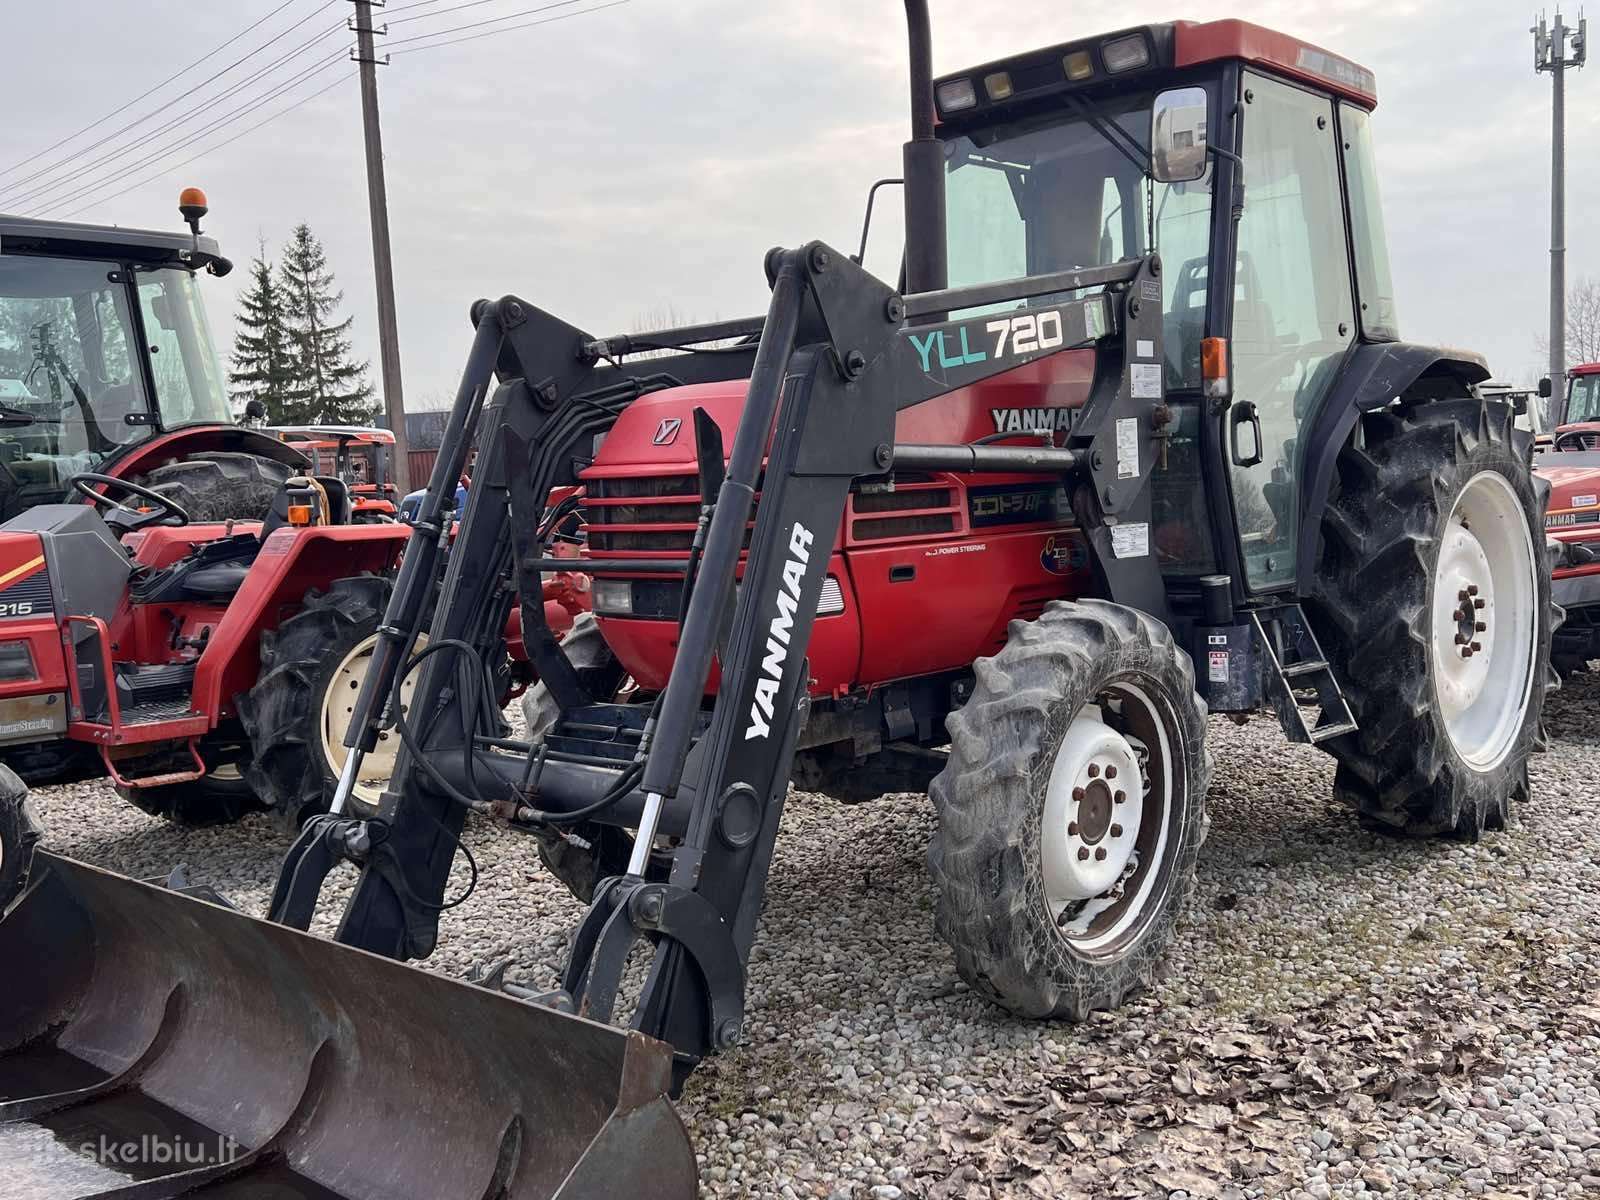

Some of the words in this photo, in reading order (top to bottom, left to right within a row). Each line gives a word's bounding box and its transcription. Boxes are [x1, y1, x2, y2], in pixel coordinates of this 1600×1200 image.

[908, 326, 987, 373] YLL
[986, 310, 1064, 359] 720
[1543, 513, 1576, 527] ANMAR
[744, 521, 815, 741] YANMAR
